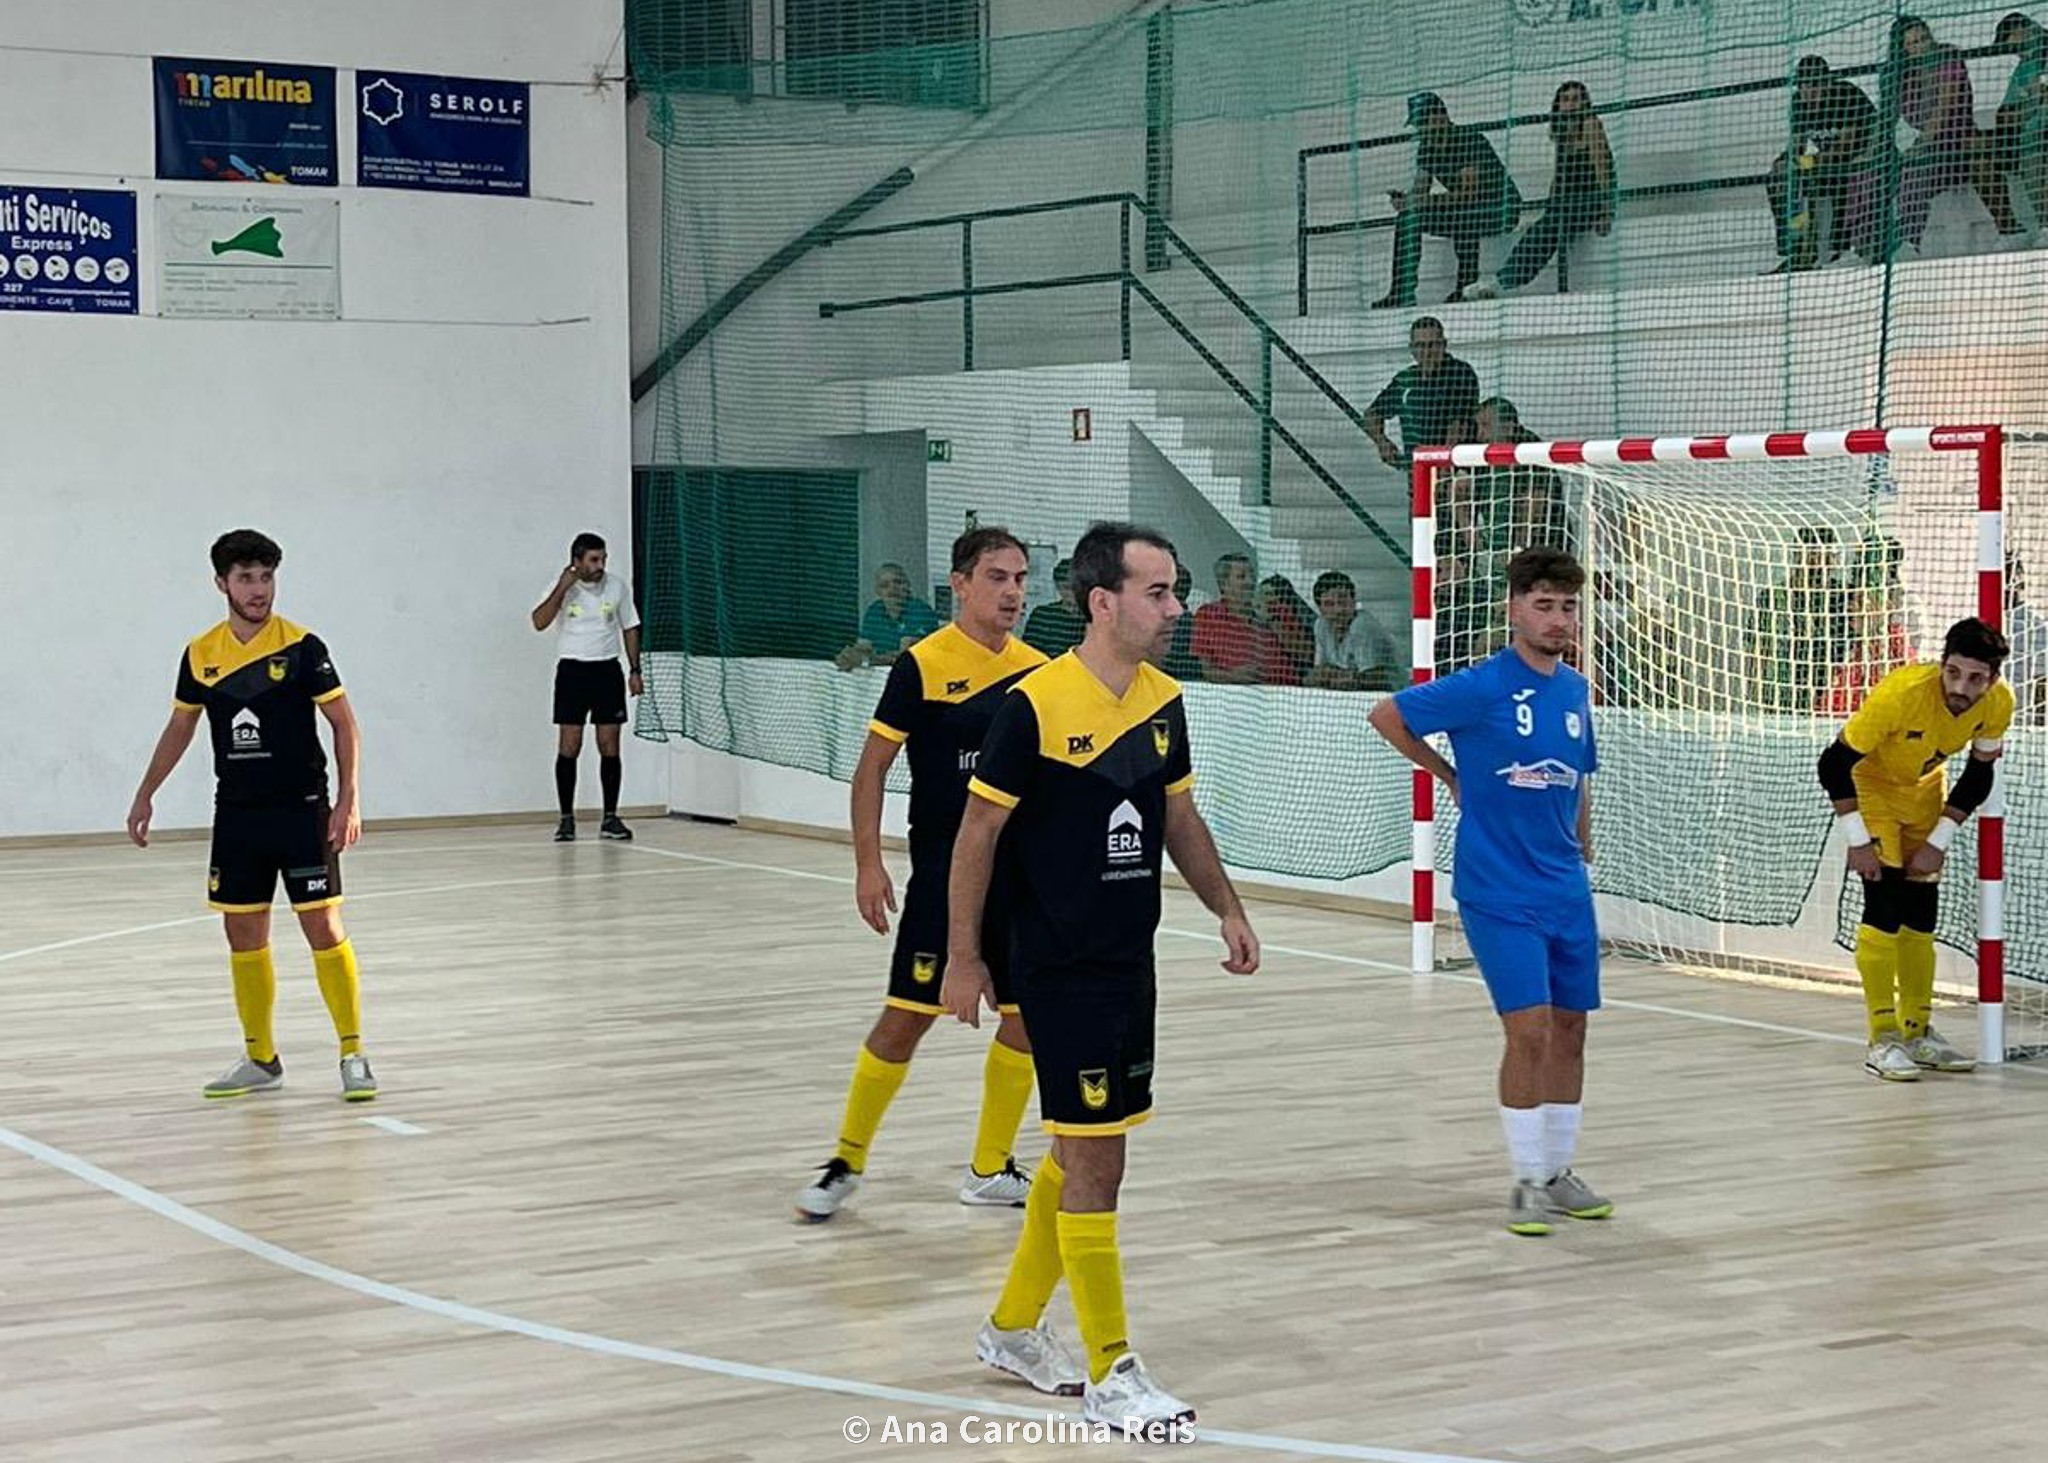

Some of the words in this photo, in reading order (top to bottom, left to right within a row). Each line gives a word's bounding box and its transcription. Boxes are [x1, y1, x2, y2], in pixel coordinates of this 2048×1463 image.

[430, 93, 523, 114] SEROLF
[290, 166, 328, 177] TOMAR
[25, 194, 112, 245] Serviços
[11, 236, 73, 253] Express
[95, 298, 131, 308] TOMAR
[1516, 703, 1533, 737] 9
[233, 729, 260, 740] ERA
[1067, 734, 1095, 755] DK
[1107, 832, 1142, 851] ERA
[307, 879, 328, 891] DK
